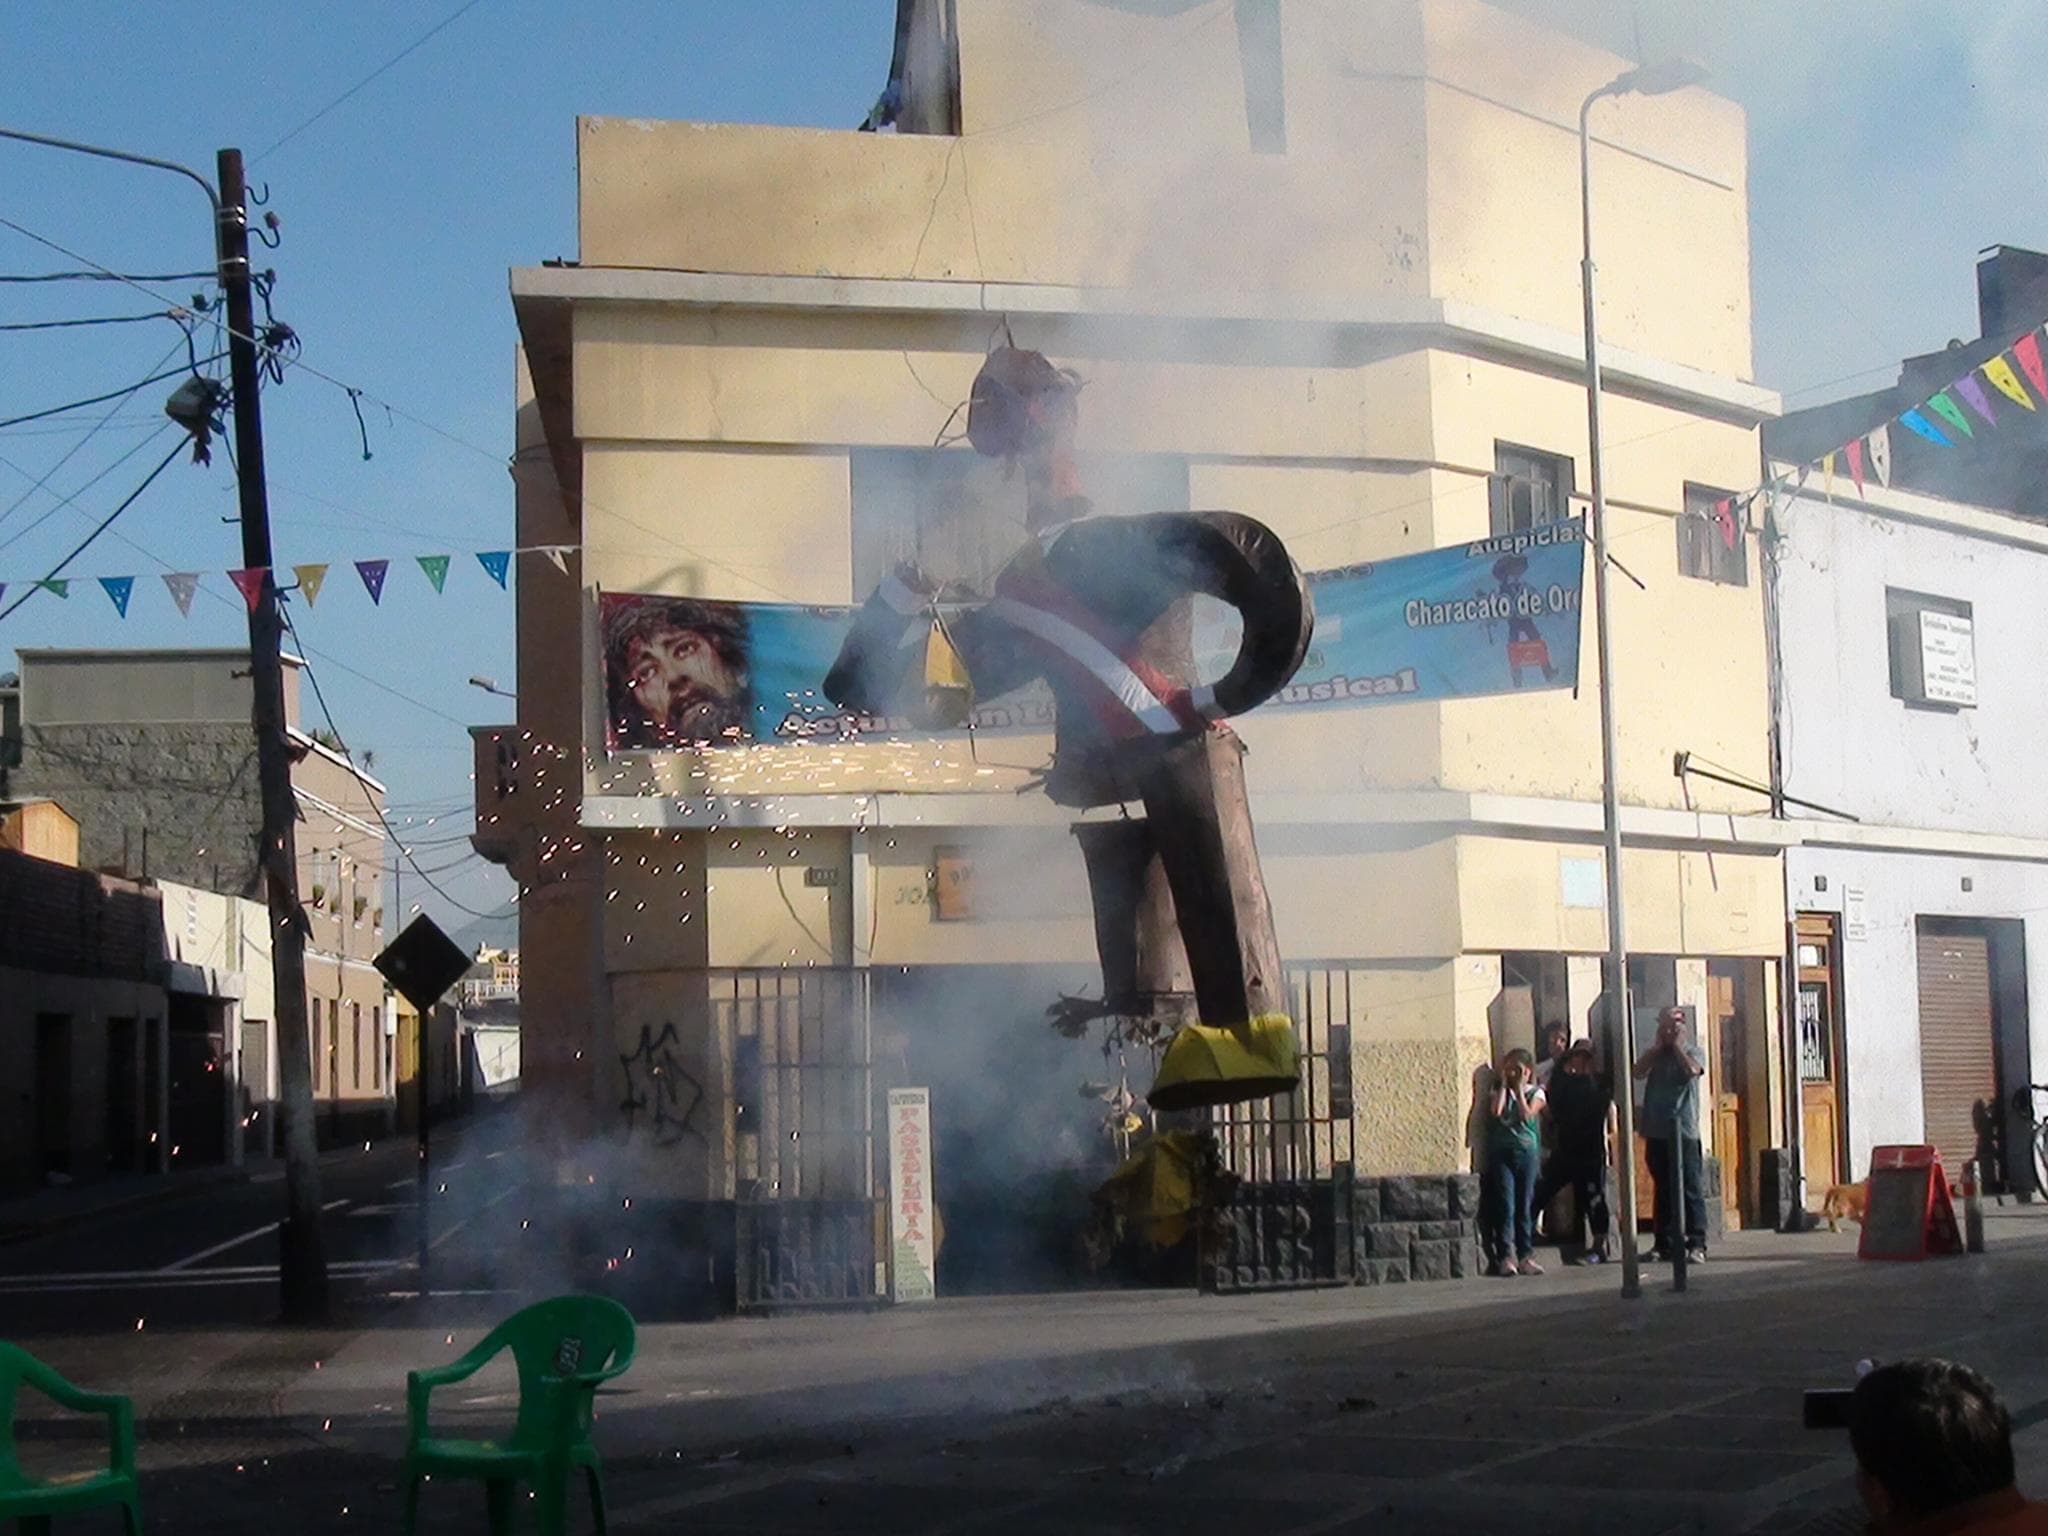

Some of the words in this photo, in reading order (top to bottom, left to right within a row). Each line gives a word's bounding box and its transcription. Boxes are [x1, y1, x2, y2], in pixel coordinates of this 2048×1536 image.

[1405, 592, 1510, 628] Characato
[1516, 587, 1542, 616] de
[1264, 667, 1420, 706] usical
